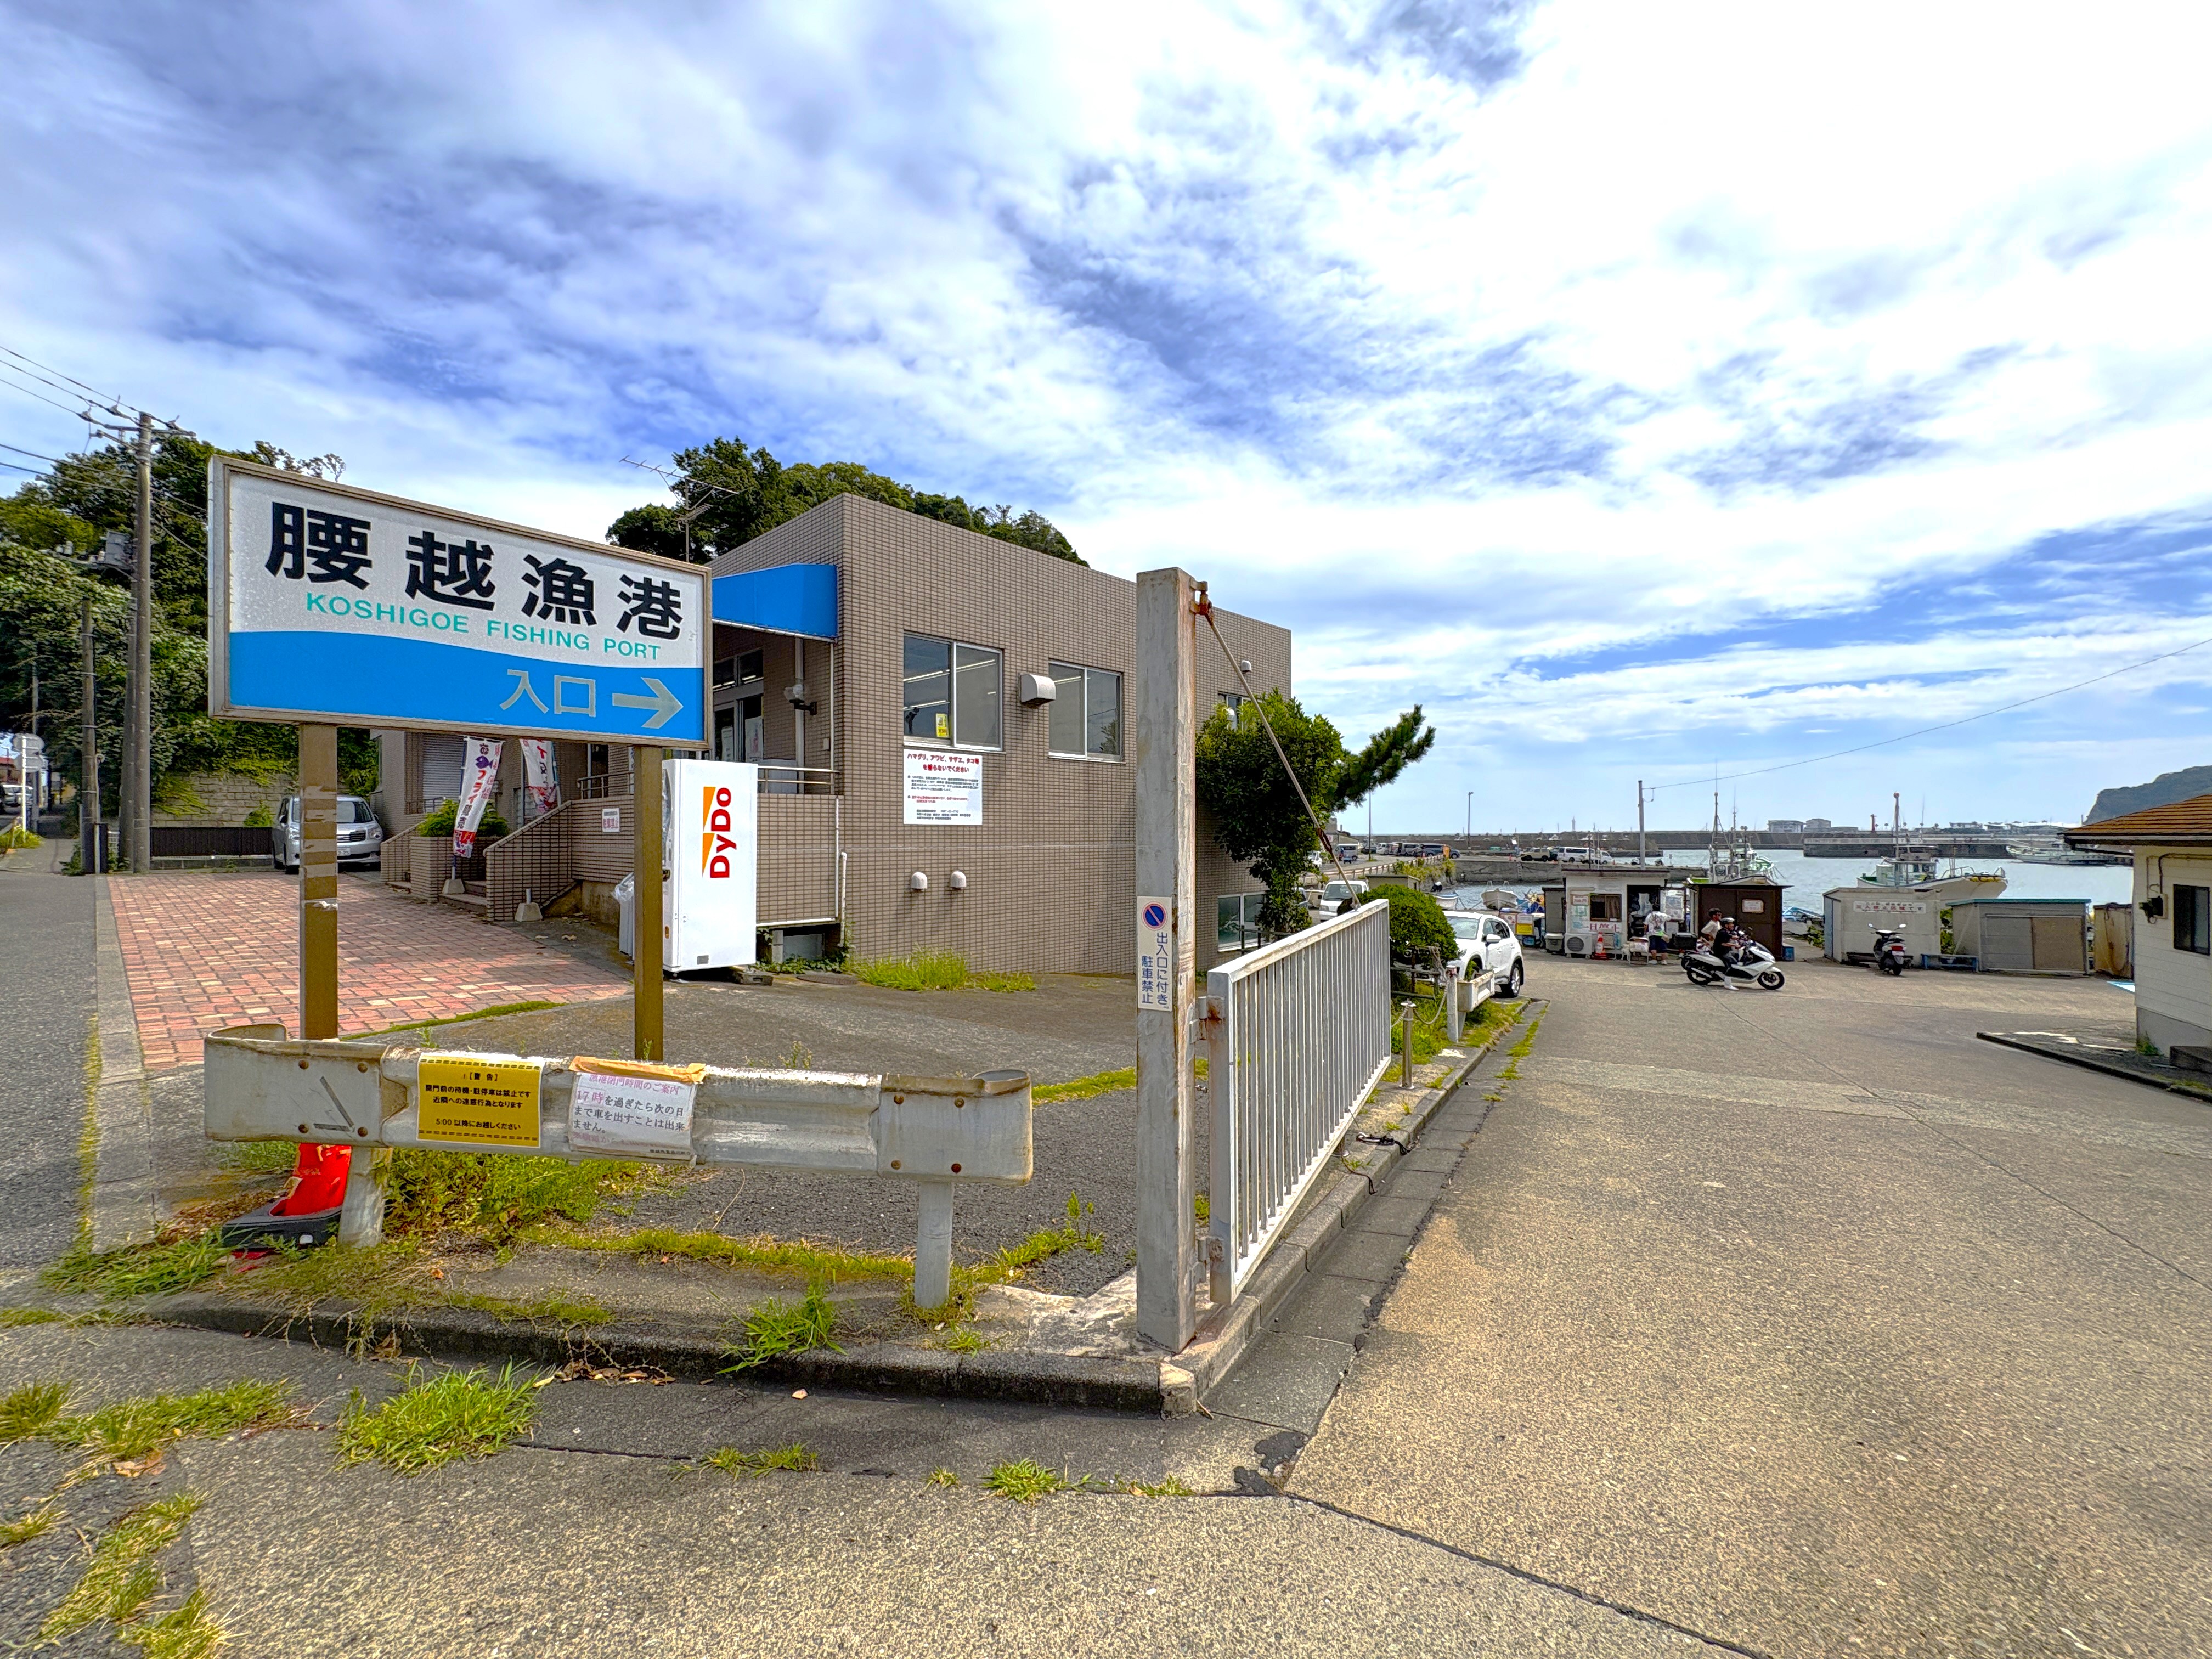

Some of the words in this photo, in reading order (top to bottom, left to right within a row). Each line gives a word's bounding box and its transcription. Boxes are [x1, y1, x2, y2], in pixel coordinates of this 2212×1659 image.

[264, 501, 684, 641] 腰越漁港
[306, 592, 469, 634] KOSHIGOE
[487, 621, 590, 651] FISHING
[603, 638, 661, 661] PORT
[500, 669, 596, 718] 入口
[710, 787, 737, 878] DyDo
[1142, 956, 1154, 1004] 駐車禁止
[1156, 932, 1169, 1005] 出入口に付き
[433, 1096, 523, 1109] 近隣への迷惑行為となります
[573, 1119, 606, 1134] ません。
[574, 1106, 686, 1132] まで車を出すことは出来
